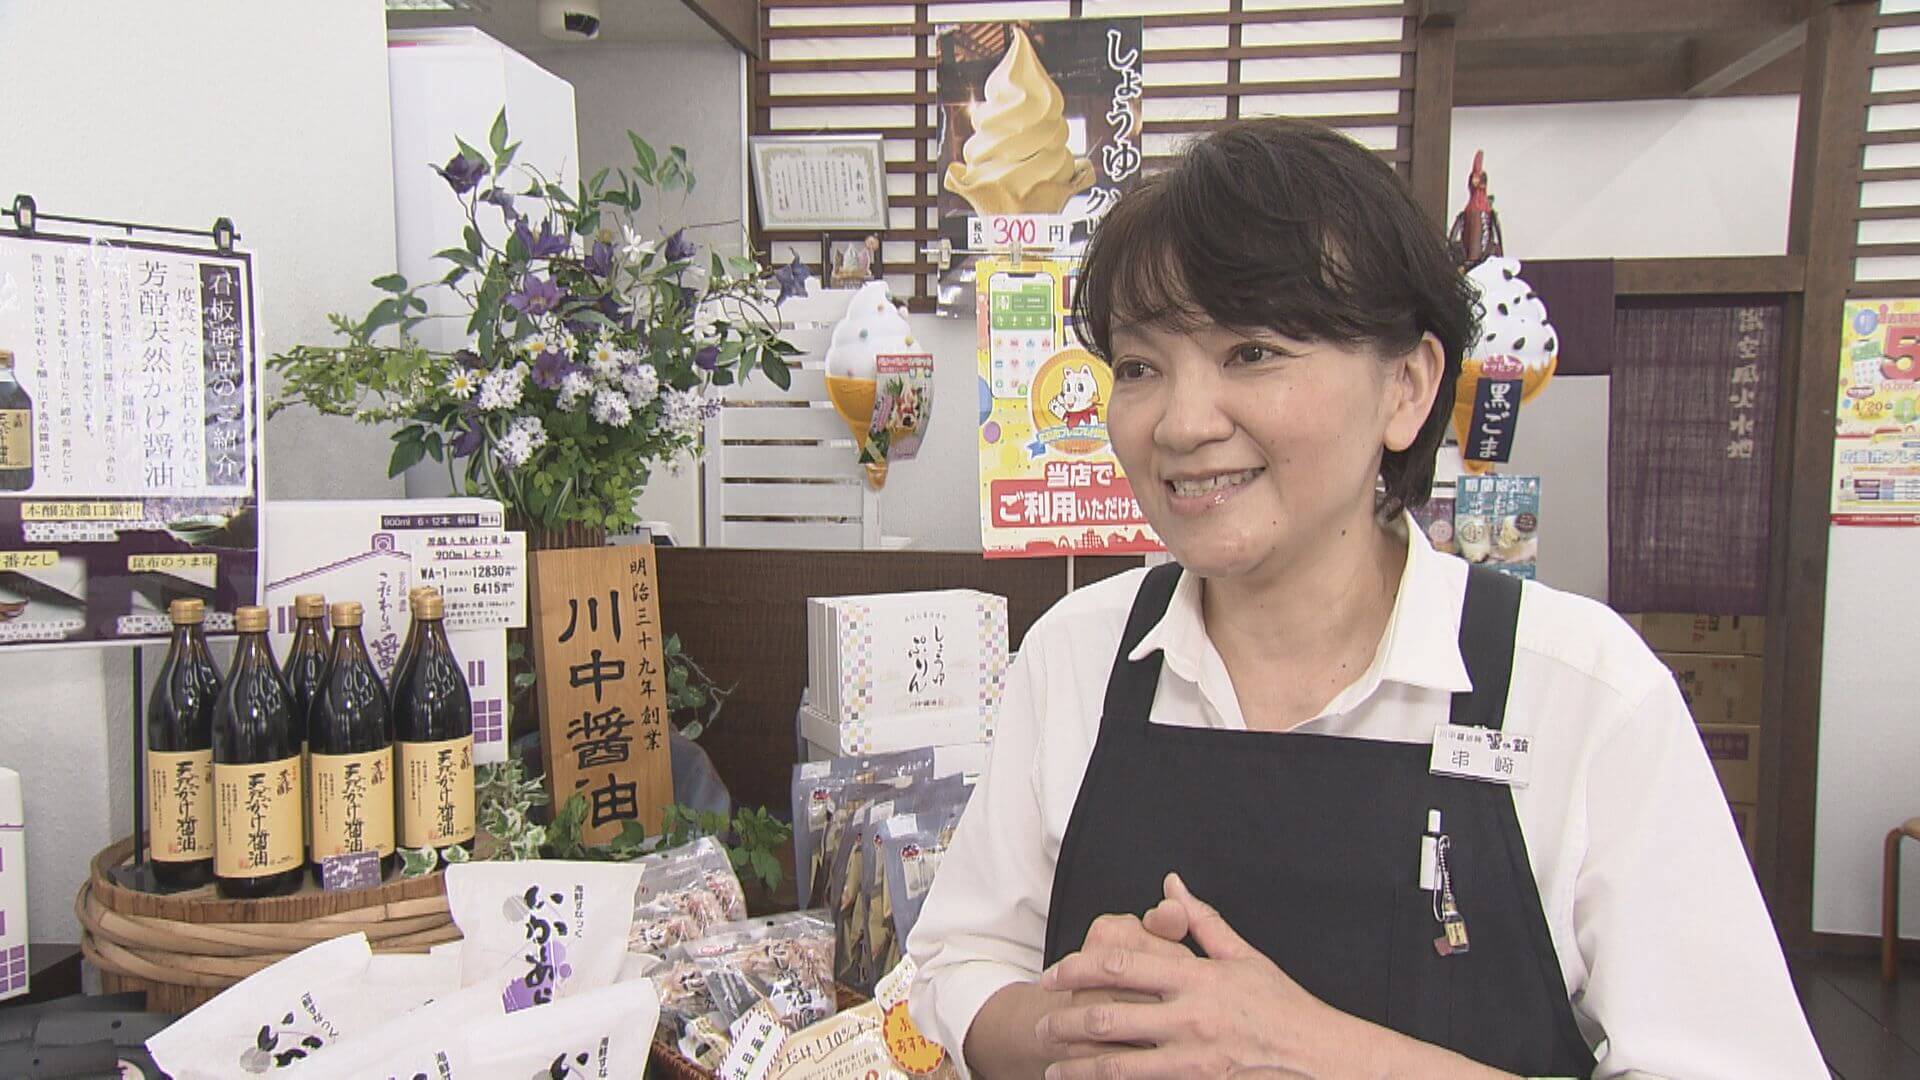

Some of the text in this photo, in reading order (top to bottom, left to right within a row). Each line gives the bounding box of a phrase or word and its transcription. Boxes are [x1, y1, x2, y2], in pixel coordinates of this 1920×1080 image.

[1104, 29, 1142, 181] しょうゆ
[993, 217, 1035, 244] 300
[1049, 225, 1064, 242] 円
[138, 260, 175, 488] 芳醇天然かけ醤油
[1480, 382, 1512, 459] 黒ごま
[1047, 463, 1113, 487] 当店で
[383, 518, 411, 527] 900ml
[0, 552, 54, 566] 番だし
[132, 555, 217, 567] 昆布のうま味
[421, 567, 448, 580] WA-1
[472, 565, 505, 579] 12830
[435, 549, 503, 561] 900ml セット
[473, 583, 501, 595] 6415
[629, 557, 663, 751] 明治三十九年創業
[908, 635, 929, 693] ぷりん
[558, 590, 639, 829] 川中醤油
[175, 760, 200, 853] 天然かけ醤油
[245, 772, 272, 869] 天然かけ醤油
[436, 748, 460, 838] 天然かけ醤油
